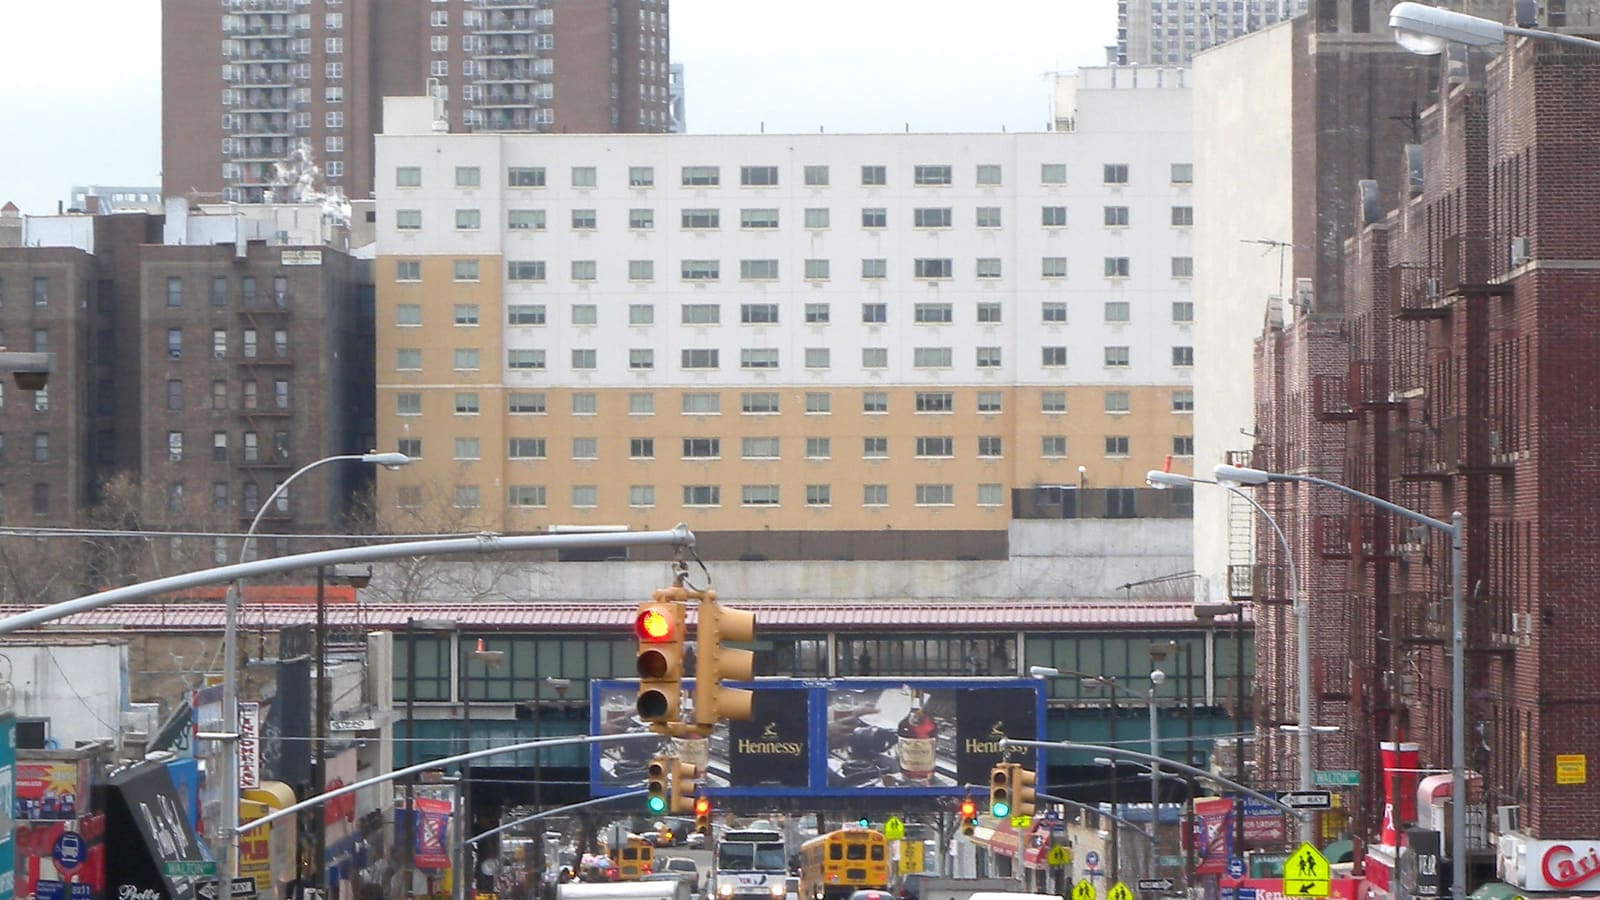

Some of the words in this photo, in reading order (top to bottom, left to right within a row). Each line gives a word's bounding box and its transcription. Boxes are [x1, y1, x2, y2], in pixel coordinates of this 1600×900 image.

[737, 739, 803, 756] Hennessy
[965, 739, 1029, 755] Hennssy
[1317, 772, 1349, 783] WALTON
[168, 862, 204, 874] WALTON
